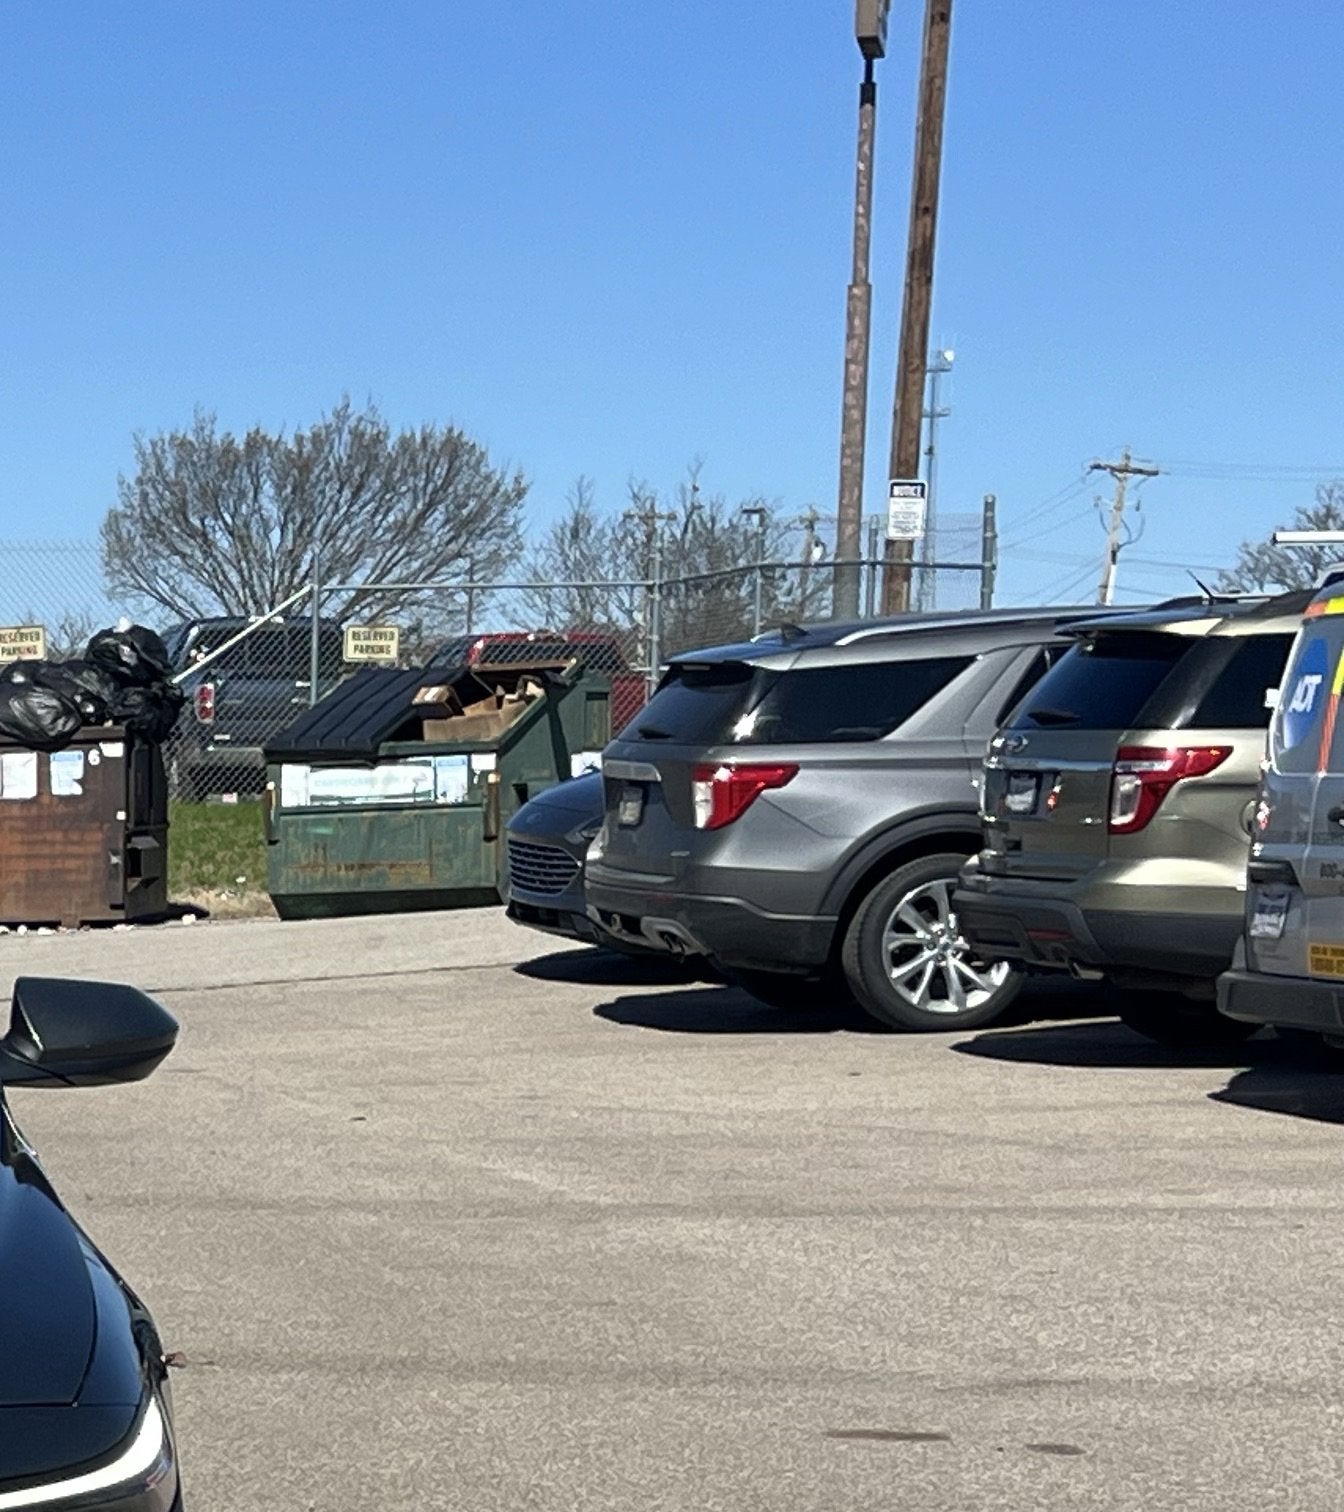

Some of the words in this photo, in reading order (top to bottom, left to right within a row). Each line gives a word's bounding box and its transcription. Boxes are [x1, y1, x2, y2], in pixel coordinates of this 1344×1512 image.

[352, 630, 395, 641] RESERVED
[354, 644, 391, 655] PARKING
[1288, 674, 1323, 713] ADT
